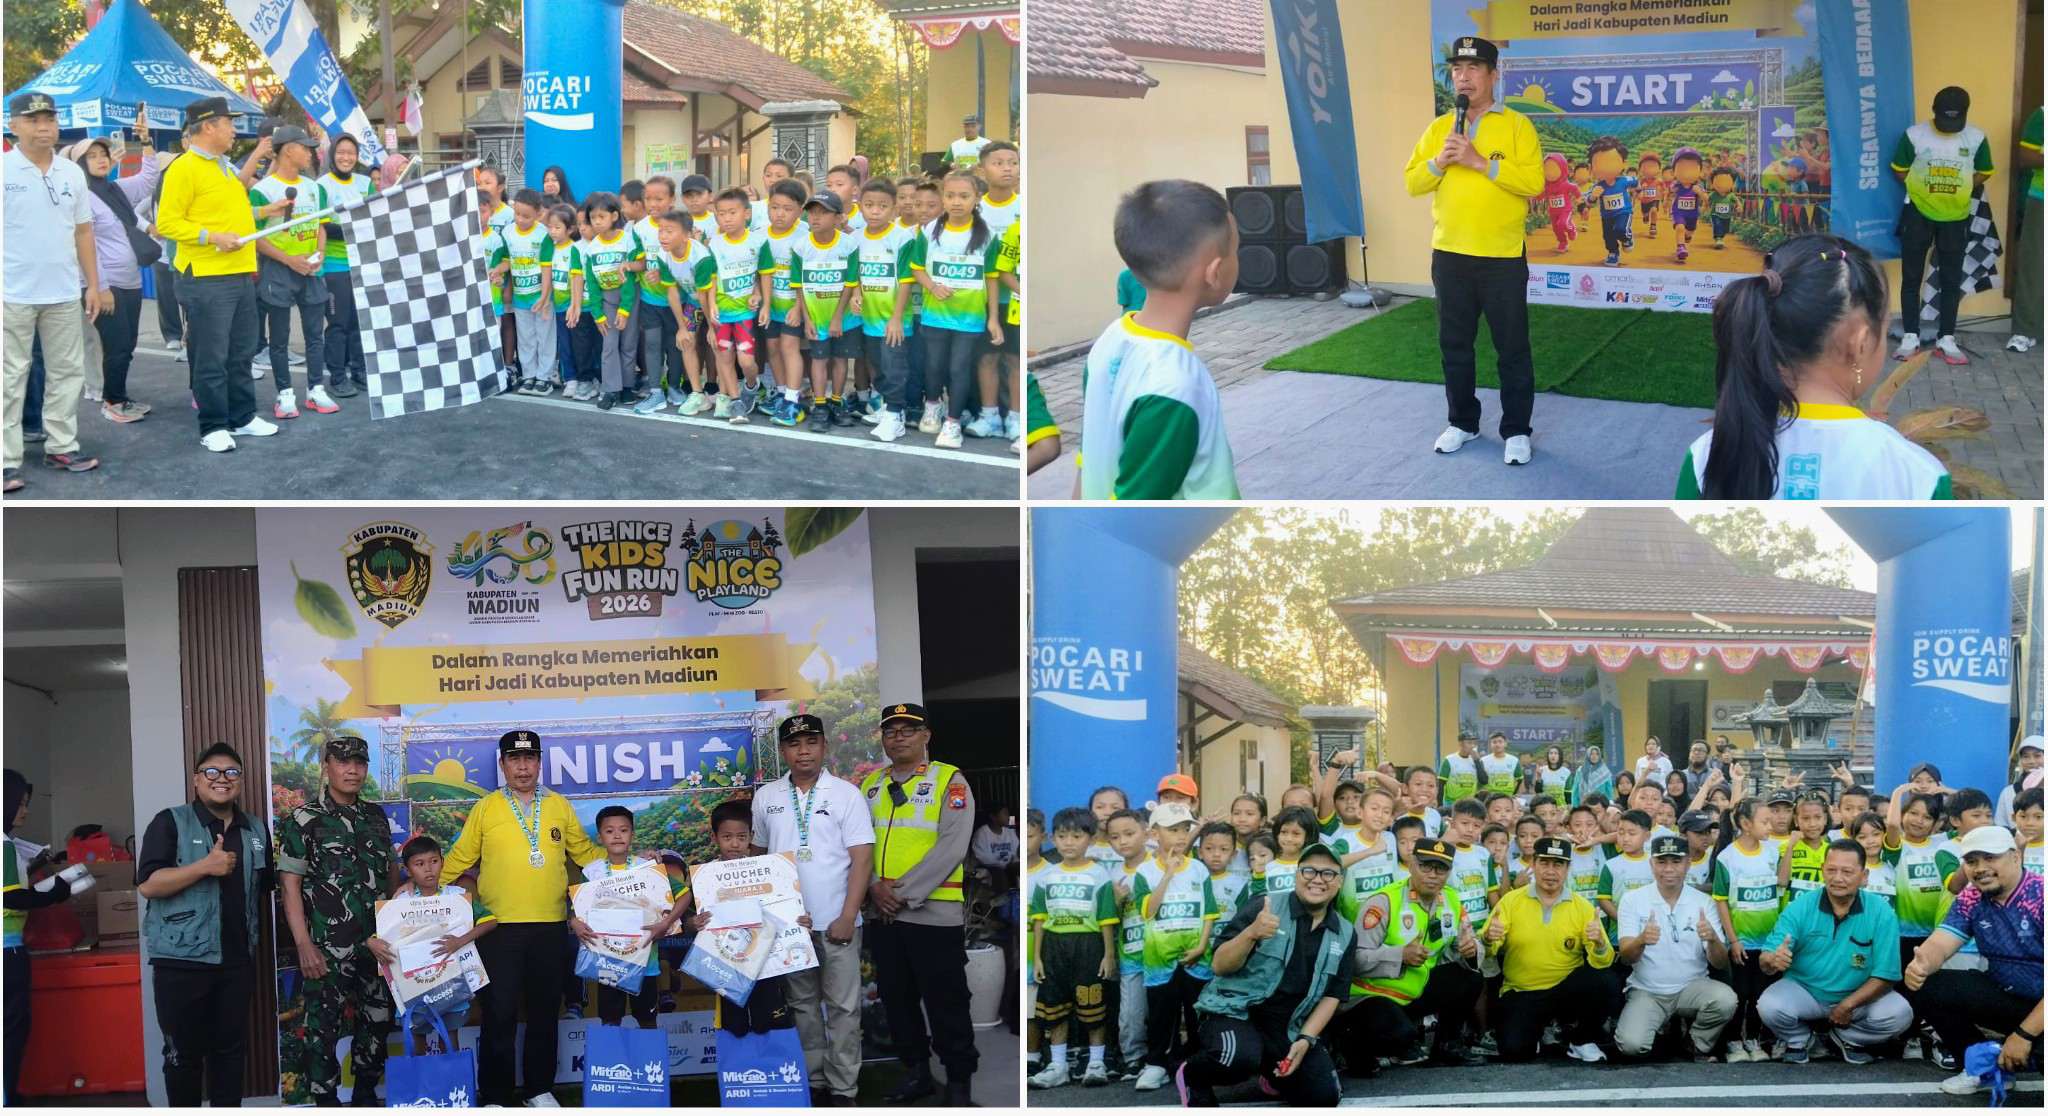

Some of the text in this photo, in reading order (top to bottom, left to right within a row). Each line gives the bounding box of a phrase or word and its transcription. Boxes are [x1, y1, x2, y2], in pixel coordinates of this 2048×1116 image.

[1530, 3, 1572, 15] Dalam
[1576, 0, 1626, 15] Rangka
[1533, 13, 1729, 31] Hari Jadi Kabupaten Madiun
[1293, 0, 1332, 125] YOIK
[1571, 73, 1693, 107] START
[1859, 84, 1880, 190] SEGARNYA
[1607, 199, 1622, 207] 101
[808, 271, 842, 282] 0069
[859, 263, 889, 276] 0053
[938, 265, 977, 278] 0049
[515, 275, 539, 287] 0078
[353, 525, 419, 543] KABUPATEN
[563, 521, 671, 546] THE NICE
[581, 542, 665, 570] KIDS
[721, 549, 743, 557] THE
[687, 558, 781, 592] NICE
[564, 568, 677, 598] FUN RUN
[467, 590, 517, 599] KABUPATEN
[697, 584, 770, 602] PLAYLAND
[367, 603, 417, 617] MADIUN
[468, 599, 540, 614] MADIUN
[600, 593, 652, 614] 2026
[432, 645, 719, 670] Dalam Rangka Memeriahkan
[1912, 657, 2009, 679] SWEAT
[439, 666, 718, 692] Hari Jadi Kabupaten Madiun
[1031, 668, 1131, 692] SWEAT
[1513, 729, 1555, 740] START
[716, 867, 772, 882] VOUCHER
[1049, 885, 1087, 897] 0036
[1743, 887, 1773, 901] 0049
[401, 907, 452, 919] VOUCHER
[1159, 903, 1195, 918] 0082
[784, 927, 802, 939] API
[591, 1083, 615, 1093] ARDI
[725, 1089, 750, 1098] ARDI
